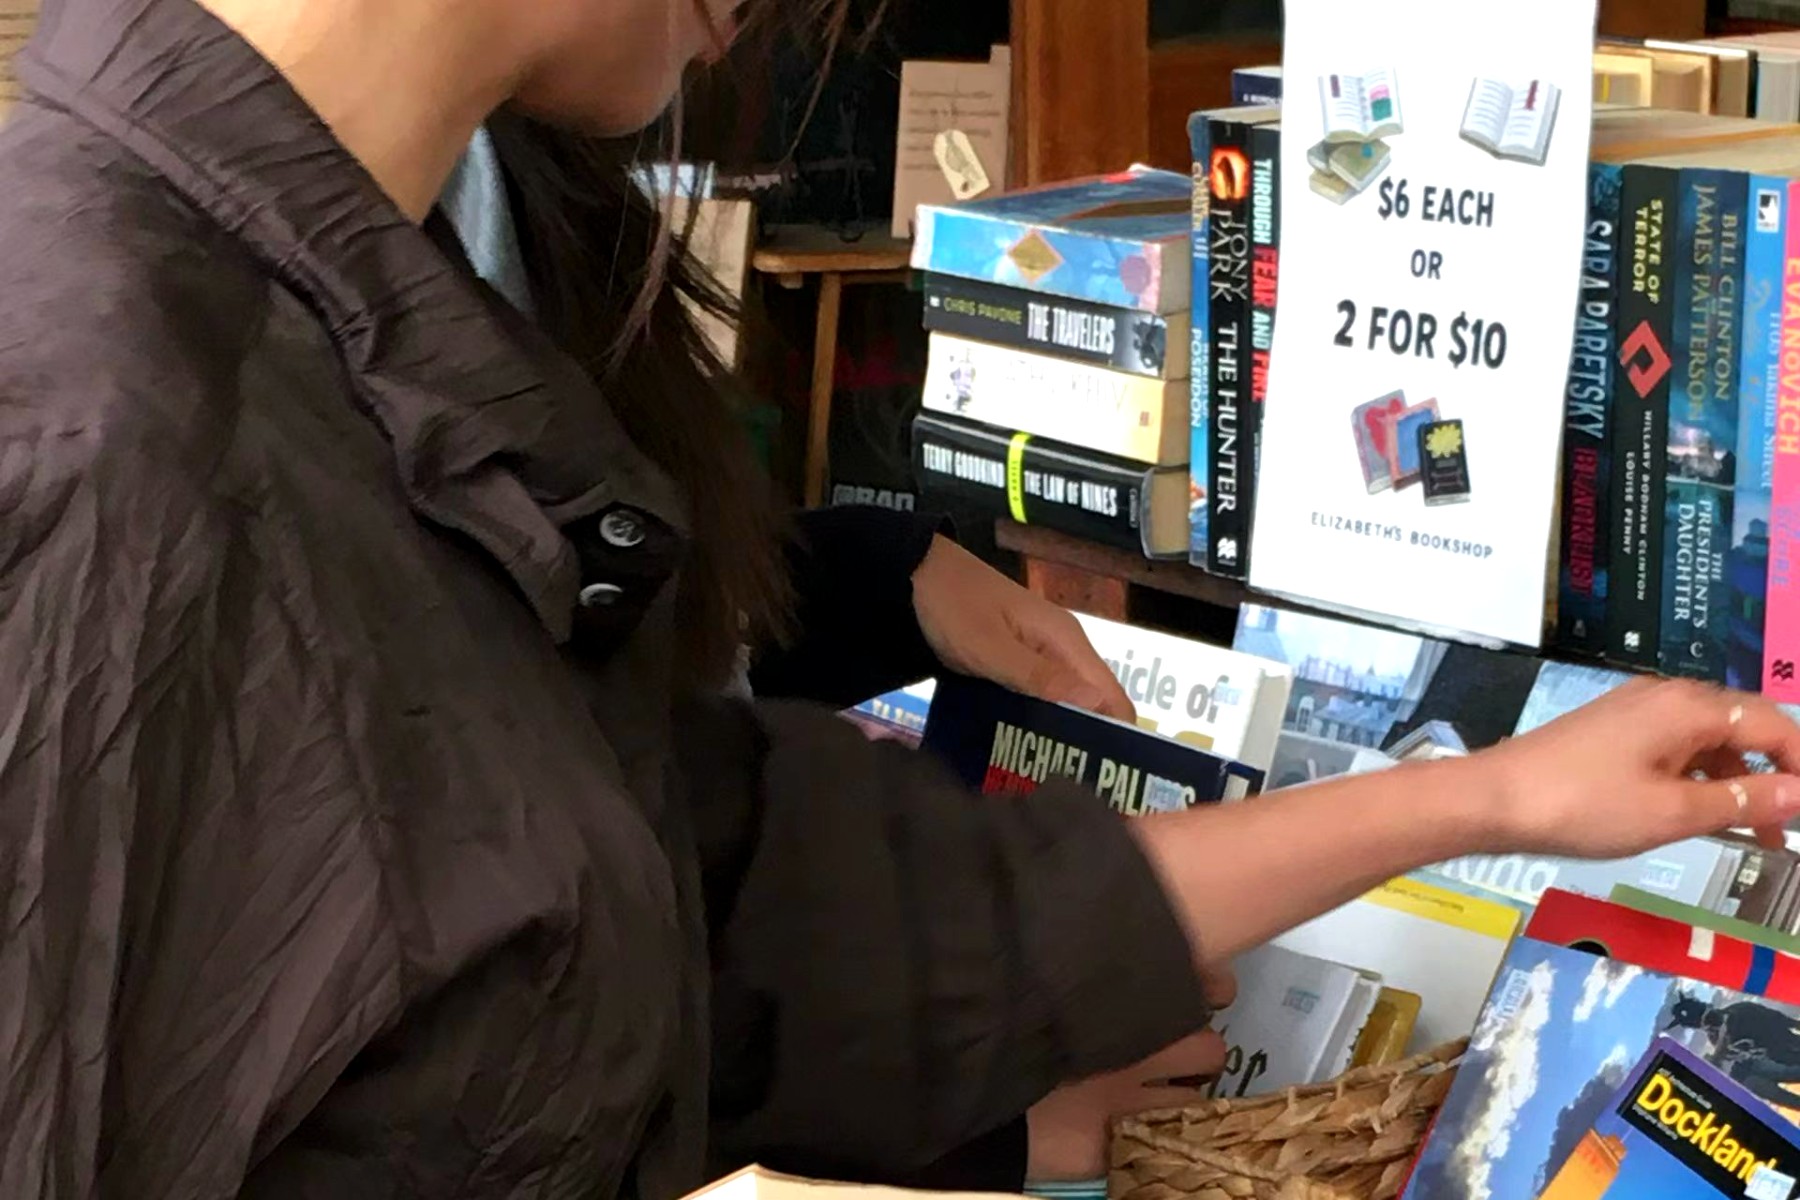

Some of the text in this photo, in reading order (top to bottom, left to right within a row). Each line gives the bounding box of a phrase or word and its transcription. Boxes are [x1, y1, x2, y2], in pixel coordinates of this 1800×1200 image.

[1253, 158, 1272, 244] THROUGH
[1378, 176, 1494, 228] $6 EACH
[1210, 208, 1232, 302] PARK
[1229, 217, 1248, 301] TONY
[1253, 245, 1278, 307] FEAR
[1410, 249, 1443, 280] OR
[1632, 207, 1649, 293] TERROR
[1647, 198, 1664, 304] STATE OF
[944, 296, 976, 316] CHRIS
[1027, 302, 1116, 355] THE TRAVELERS
[1252, 310, 1271, 350] AND
[1334, 298, 1507, 370] 2 FOR $10
[1567, 220, 1613, 439] SARA PARETSKY
[1686, 183, 1716, 422] JAMES PATTERSON
[1715, 213, 1738, 401] BILL CLINTON
[1191, 327, 1203, 428] POSEIDON
[1778, 257, 1800, 455] EVANOVICH
[1217, 321, 1237, 515] THE HUNTER
[1024, 470, 1041, 496] THE
[1067, 481, 1080, 505] OF
[1623, 451, 1635, 555] LOUISE PENNY
[1636, 410, 1653, 601] HILLARY RODHAM CLINTON
[1311, 511, 1493, 559] ELIZABETH'S BOOKSHOP
[1674, 503, 1695, 621] DAUGHTER
[1693, 499, 1713, 629] PRESIDENT'S
[1711, 552, 1722, 582] THE
[1105, 650, 1177, 711] icle
[1186, 674, 1230, 724] of
